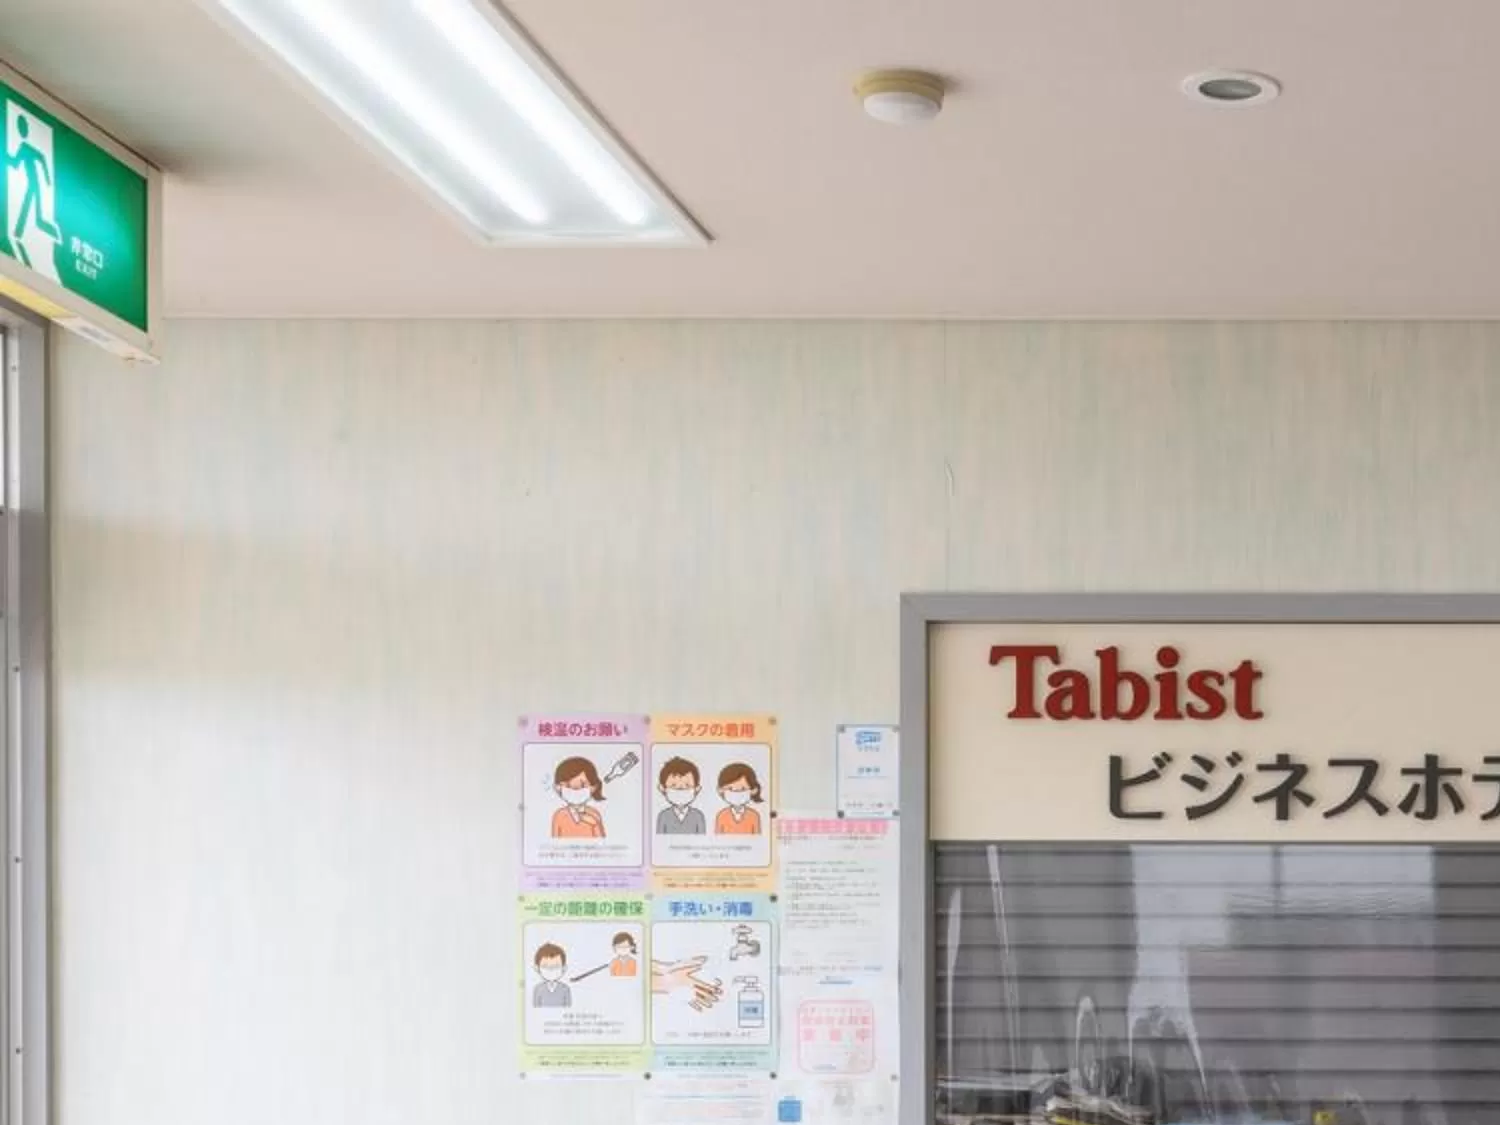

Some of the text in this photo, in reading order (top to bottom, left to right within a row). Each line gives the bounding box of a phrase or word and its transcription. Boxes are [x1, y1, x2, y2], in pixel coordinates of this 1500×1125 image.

[989, 645, 1264, 721] Tabist
[537, 722, 629, 738] 検温のお願い
[667, 723, 755, 738] マスクの着用
[524, 900, 644, 917] 一定の距離の確保
[668, 900, 754, 917] 手洗い・消毒
